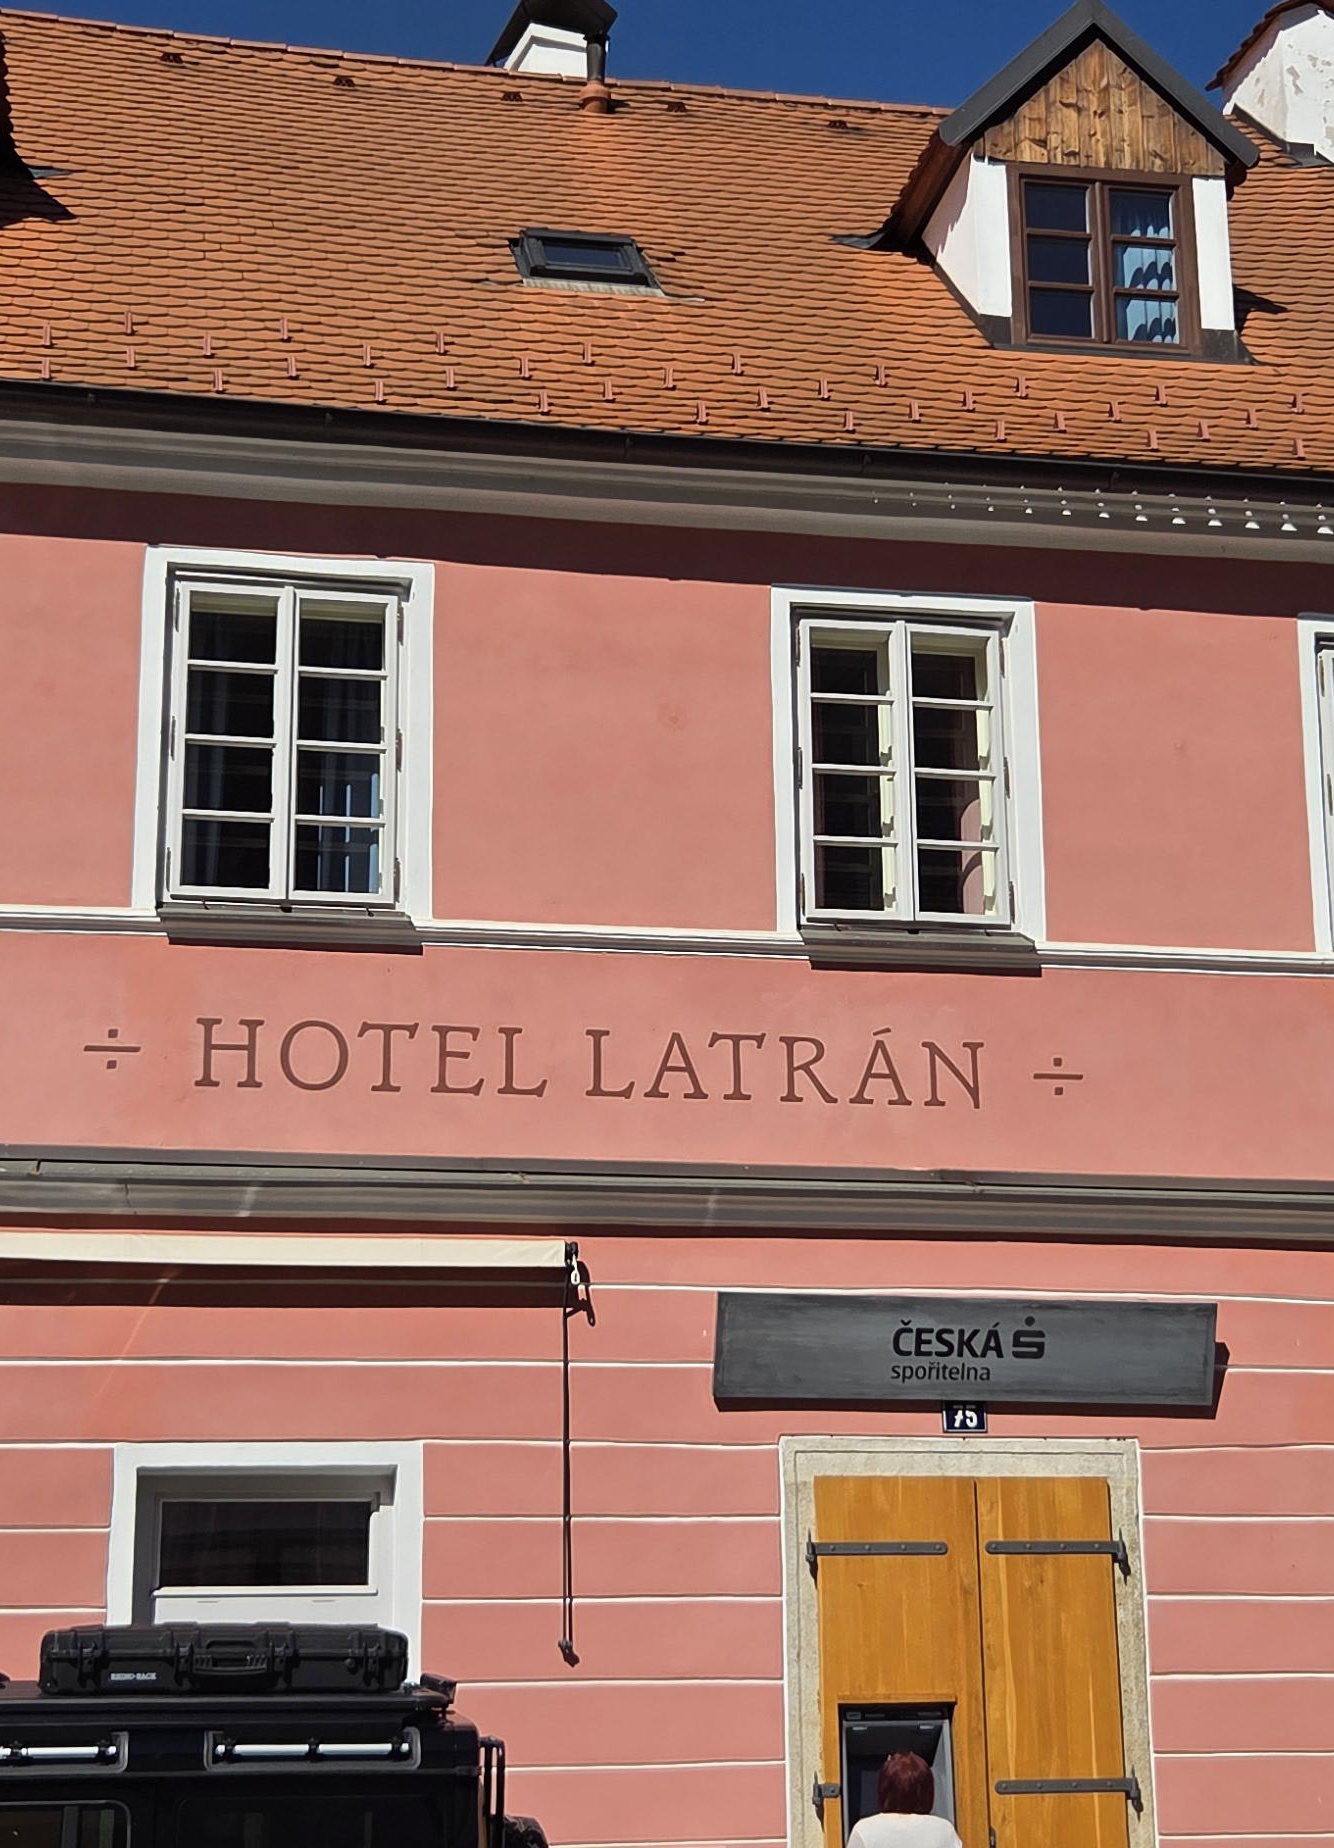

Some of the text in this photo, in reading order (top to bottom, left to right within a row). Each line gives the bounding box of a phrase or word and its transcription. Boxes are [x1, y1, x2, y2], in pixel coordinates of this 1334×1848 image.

[194, 1017, 985, 1109] HOTEL LATRÁN
[892, 1319, 1004, 1358] ČESKÁ
[891, 1362, 991, 1383] spořitelna
